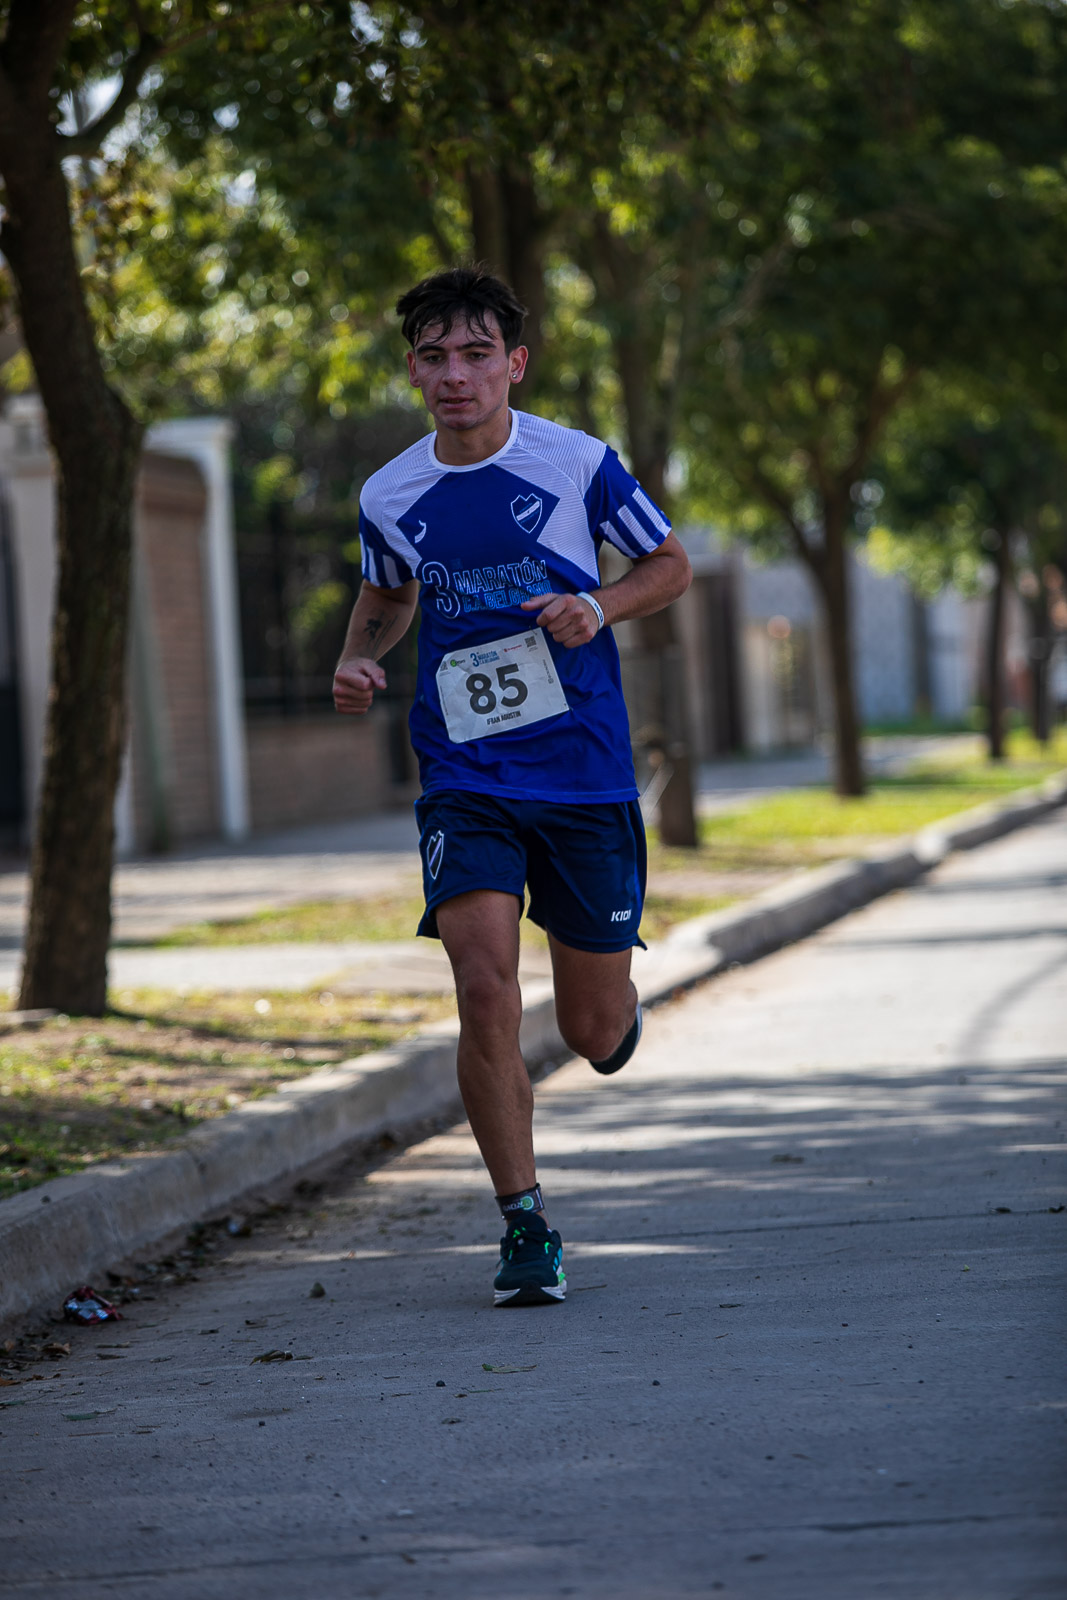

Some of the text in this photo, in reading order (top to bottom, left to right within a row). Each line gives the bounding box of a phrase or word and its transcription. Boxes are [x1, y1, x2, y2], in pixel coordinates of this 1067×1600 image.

[422, 556, 548, 620] 3 MARATÓN
[466, 663, 528, 715] 85
